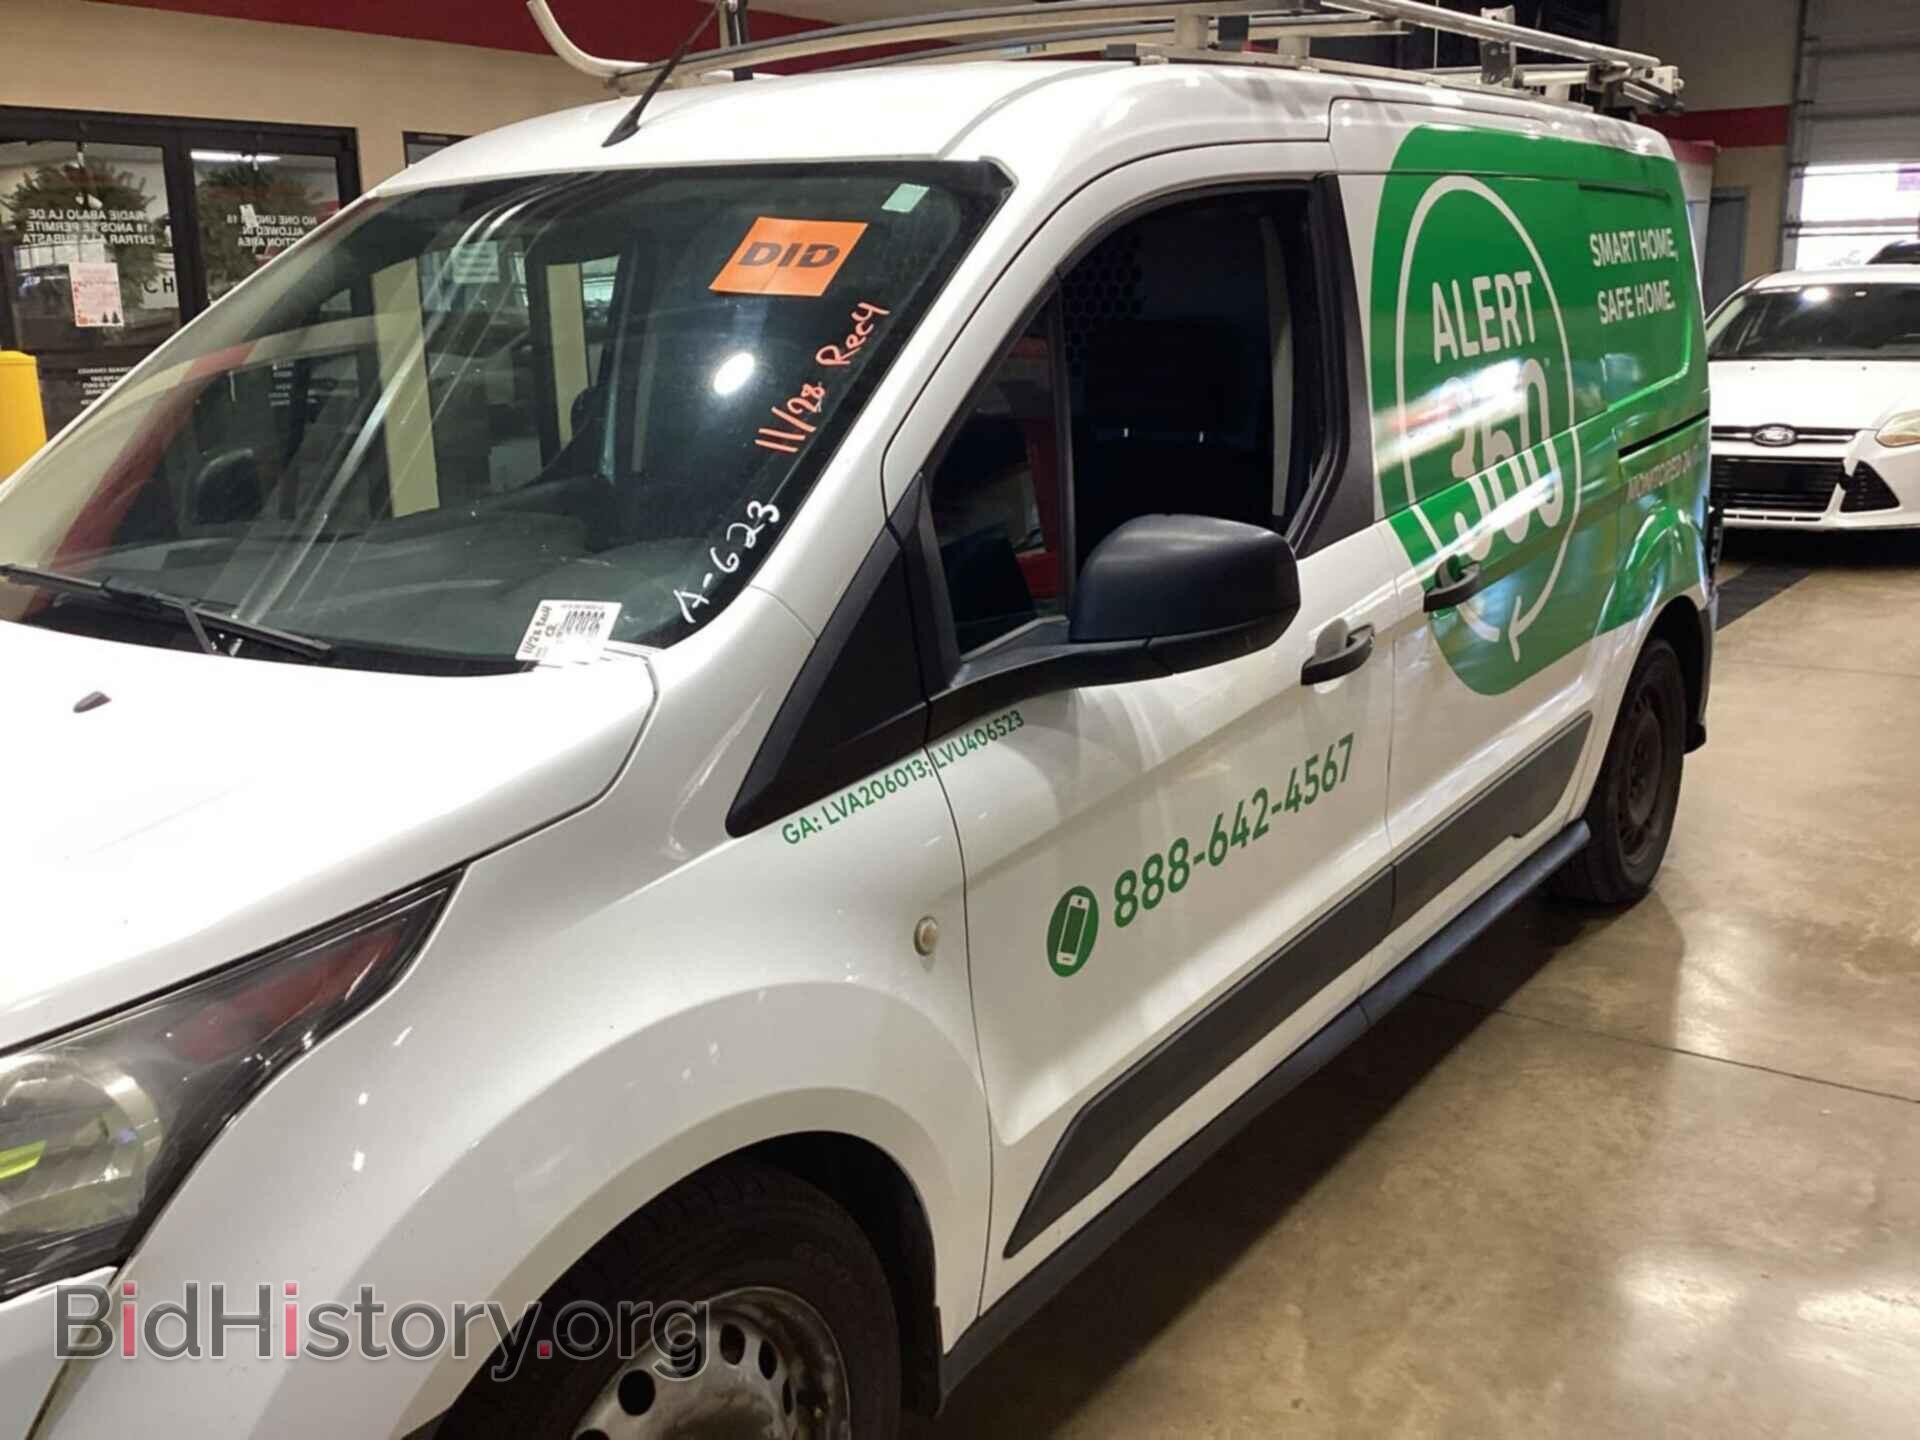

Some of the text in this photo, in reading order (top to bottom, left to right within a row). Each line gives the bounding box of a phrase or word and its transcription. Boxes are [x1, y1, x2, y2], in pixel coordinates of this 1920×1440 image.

[738, 241, 840, 268] DID
[1590, 227, 1679, 267] SMART HOME,
[1432, 271, 1535, 365] ALERT
[1598, 279, 1676, 325] SAFE HOME.
[754, 382, 826, 453] 11/28
[673, 500, 780, 623] A-623
[781, 815, 823, 845] GA:
[930, 710, 1025, 770] LVU406523
[1113, 732, 1355, 928] 888-642-4567
